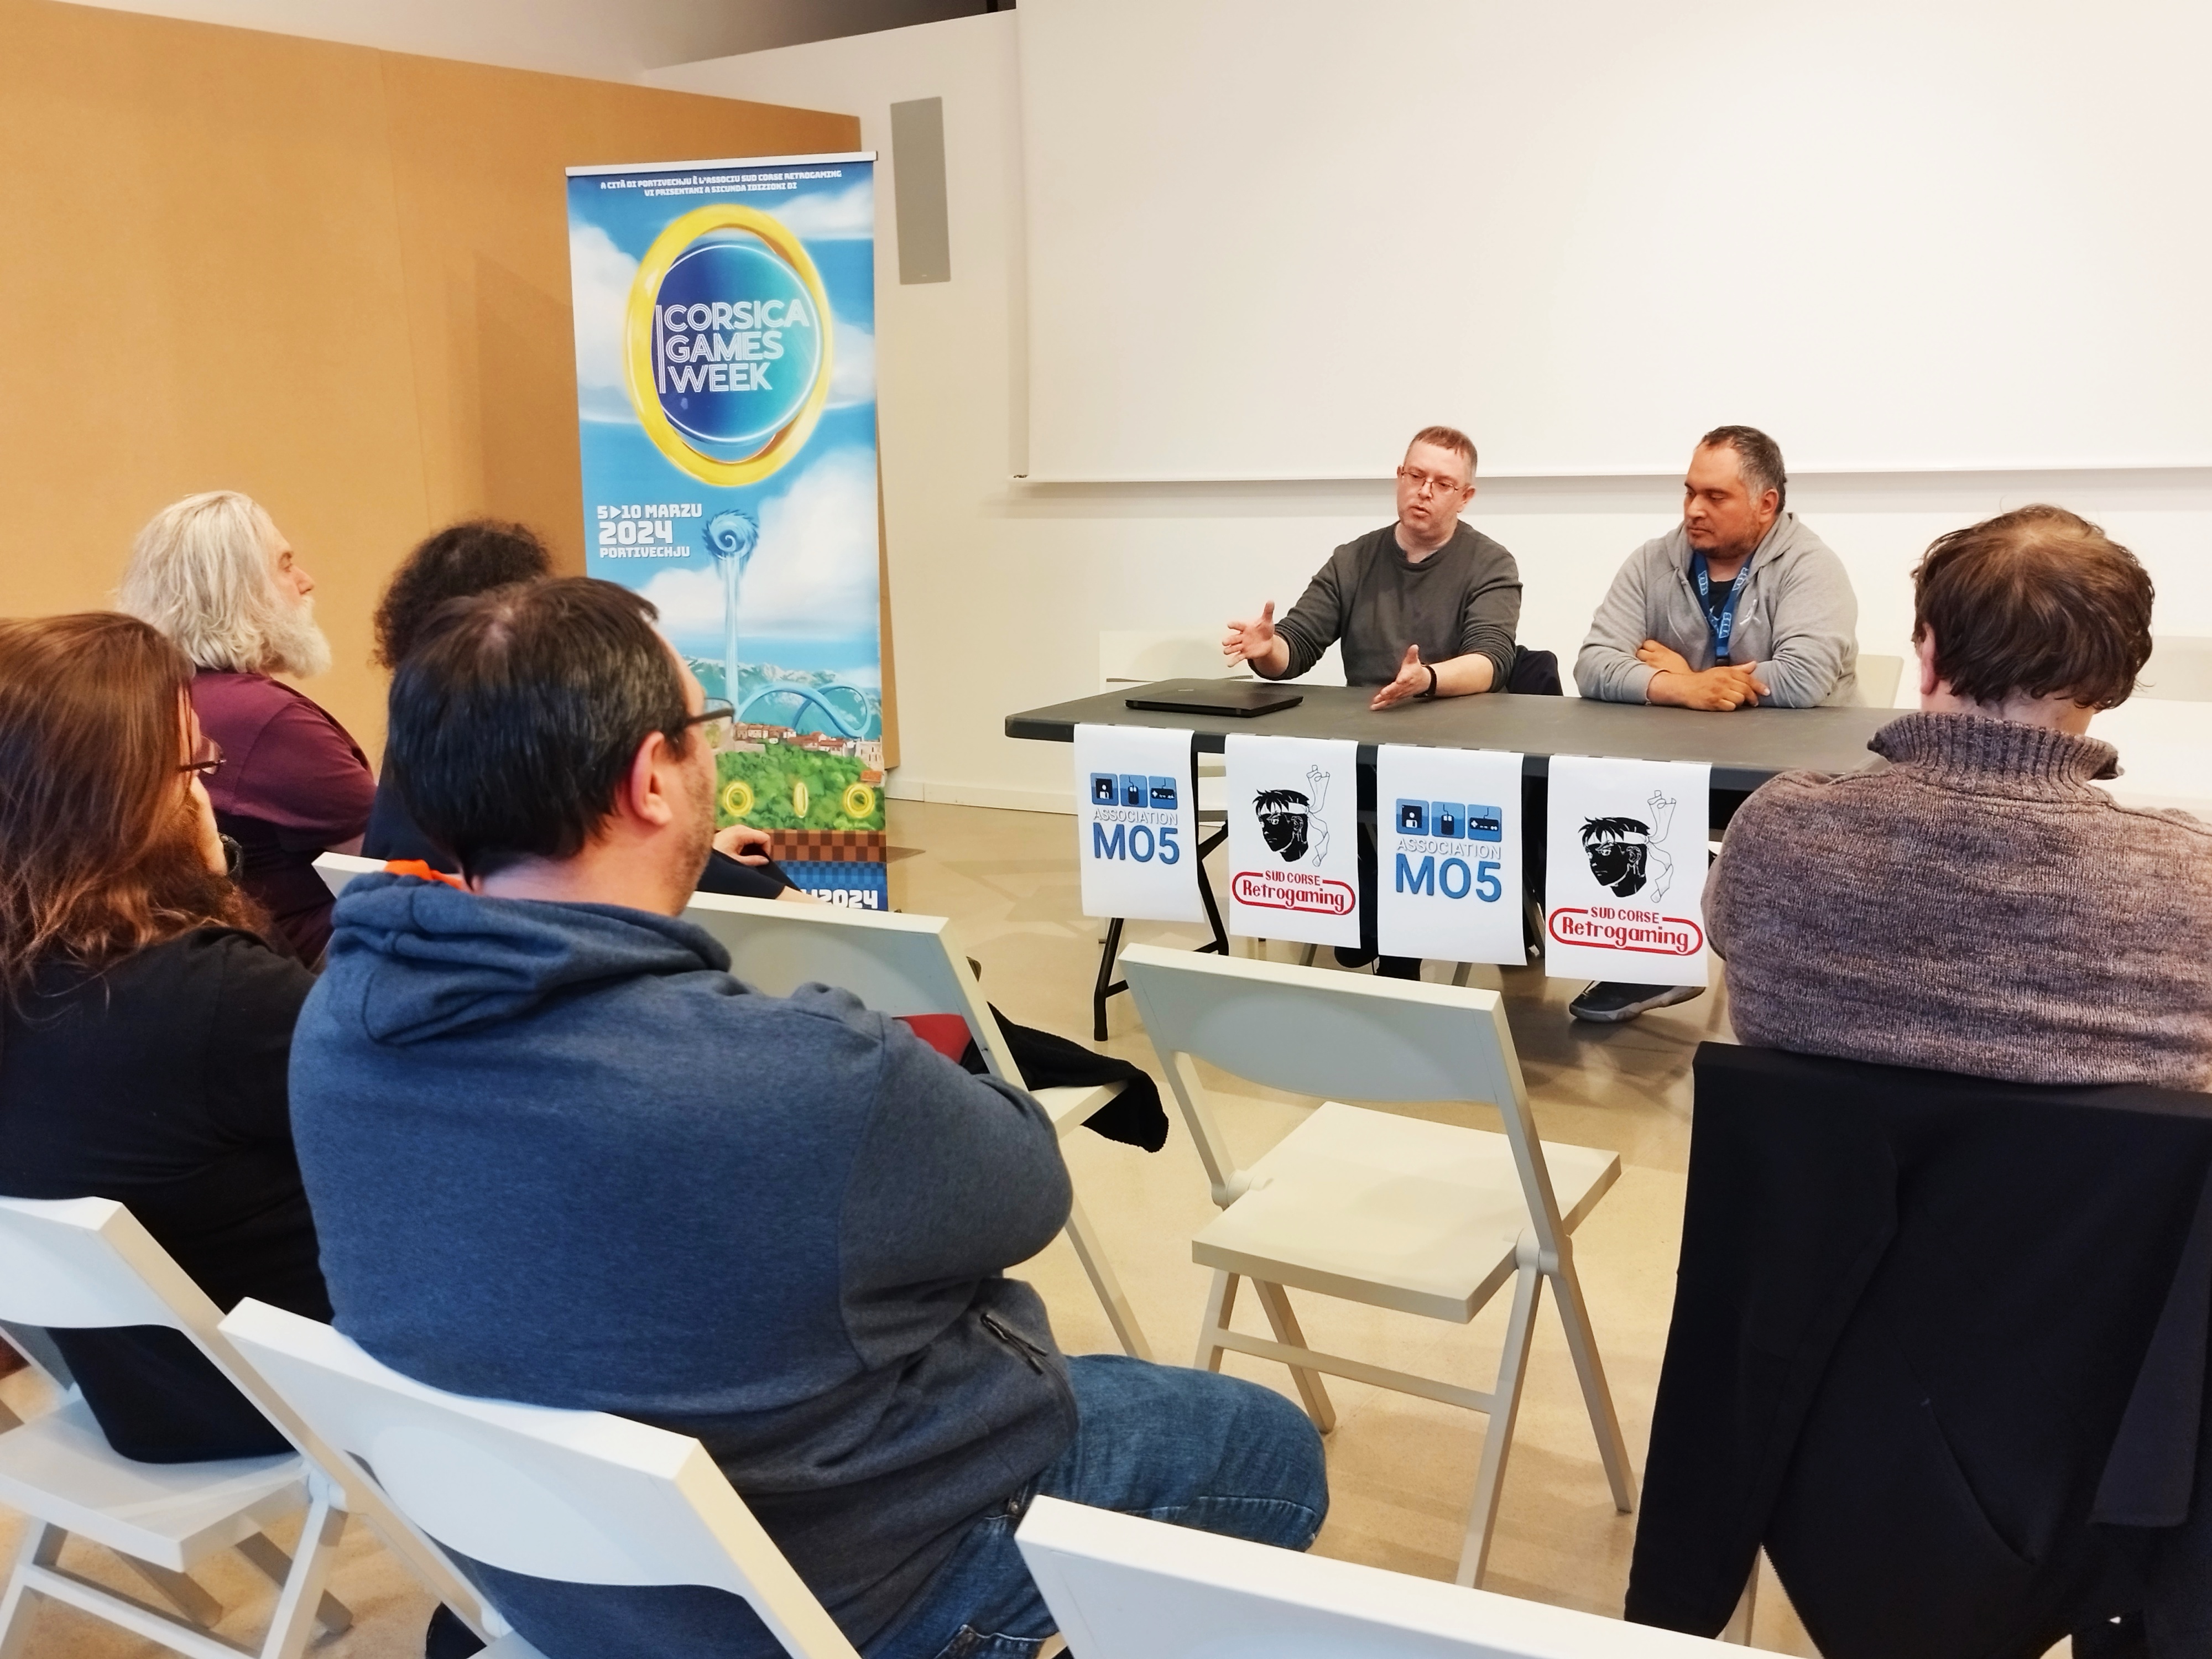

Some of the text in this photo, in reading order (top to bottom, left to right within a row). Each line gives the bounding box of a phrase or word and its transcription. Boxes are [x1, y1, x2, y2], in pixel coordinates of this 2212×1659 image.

[638, 178, 692, 187] PORTIVECHJU
[758, 173, 783, 181] CORSE
[784, 170, 842, 180] RETROGAMING
[655, 186, 703, 196] PRISENTANI
[711, 184, 747, 193] SICUNDA
[747, 182, 786, 191] IDIZIONI
[664, 299, 810, 332] CORSICA
[665, 331, 784, 363] GAMES
[667, 362, 773, 393] WEEK
[645, 503, 702, 519] MARZU
[599, 520, 673, 545] 2024
[599, 546, 690, 559] PORTIVECHJU
[1093, 808, 1178, 826] ASSOCIATION
[1093, 822, 1180, 864] MO5
[1397, 838, 1501, 860] ASSOCIATION
[1265, 870, 1321, 886] SUD CORSE
[1396, 853, 1501, 902] MO5
[1243, 879, 1344, 912] Retrogaming
[1590, 906, 1660, 924] SUD CORSE
[1562, 916, 1688, 953] Retrogaming
